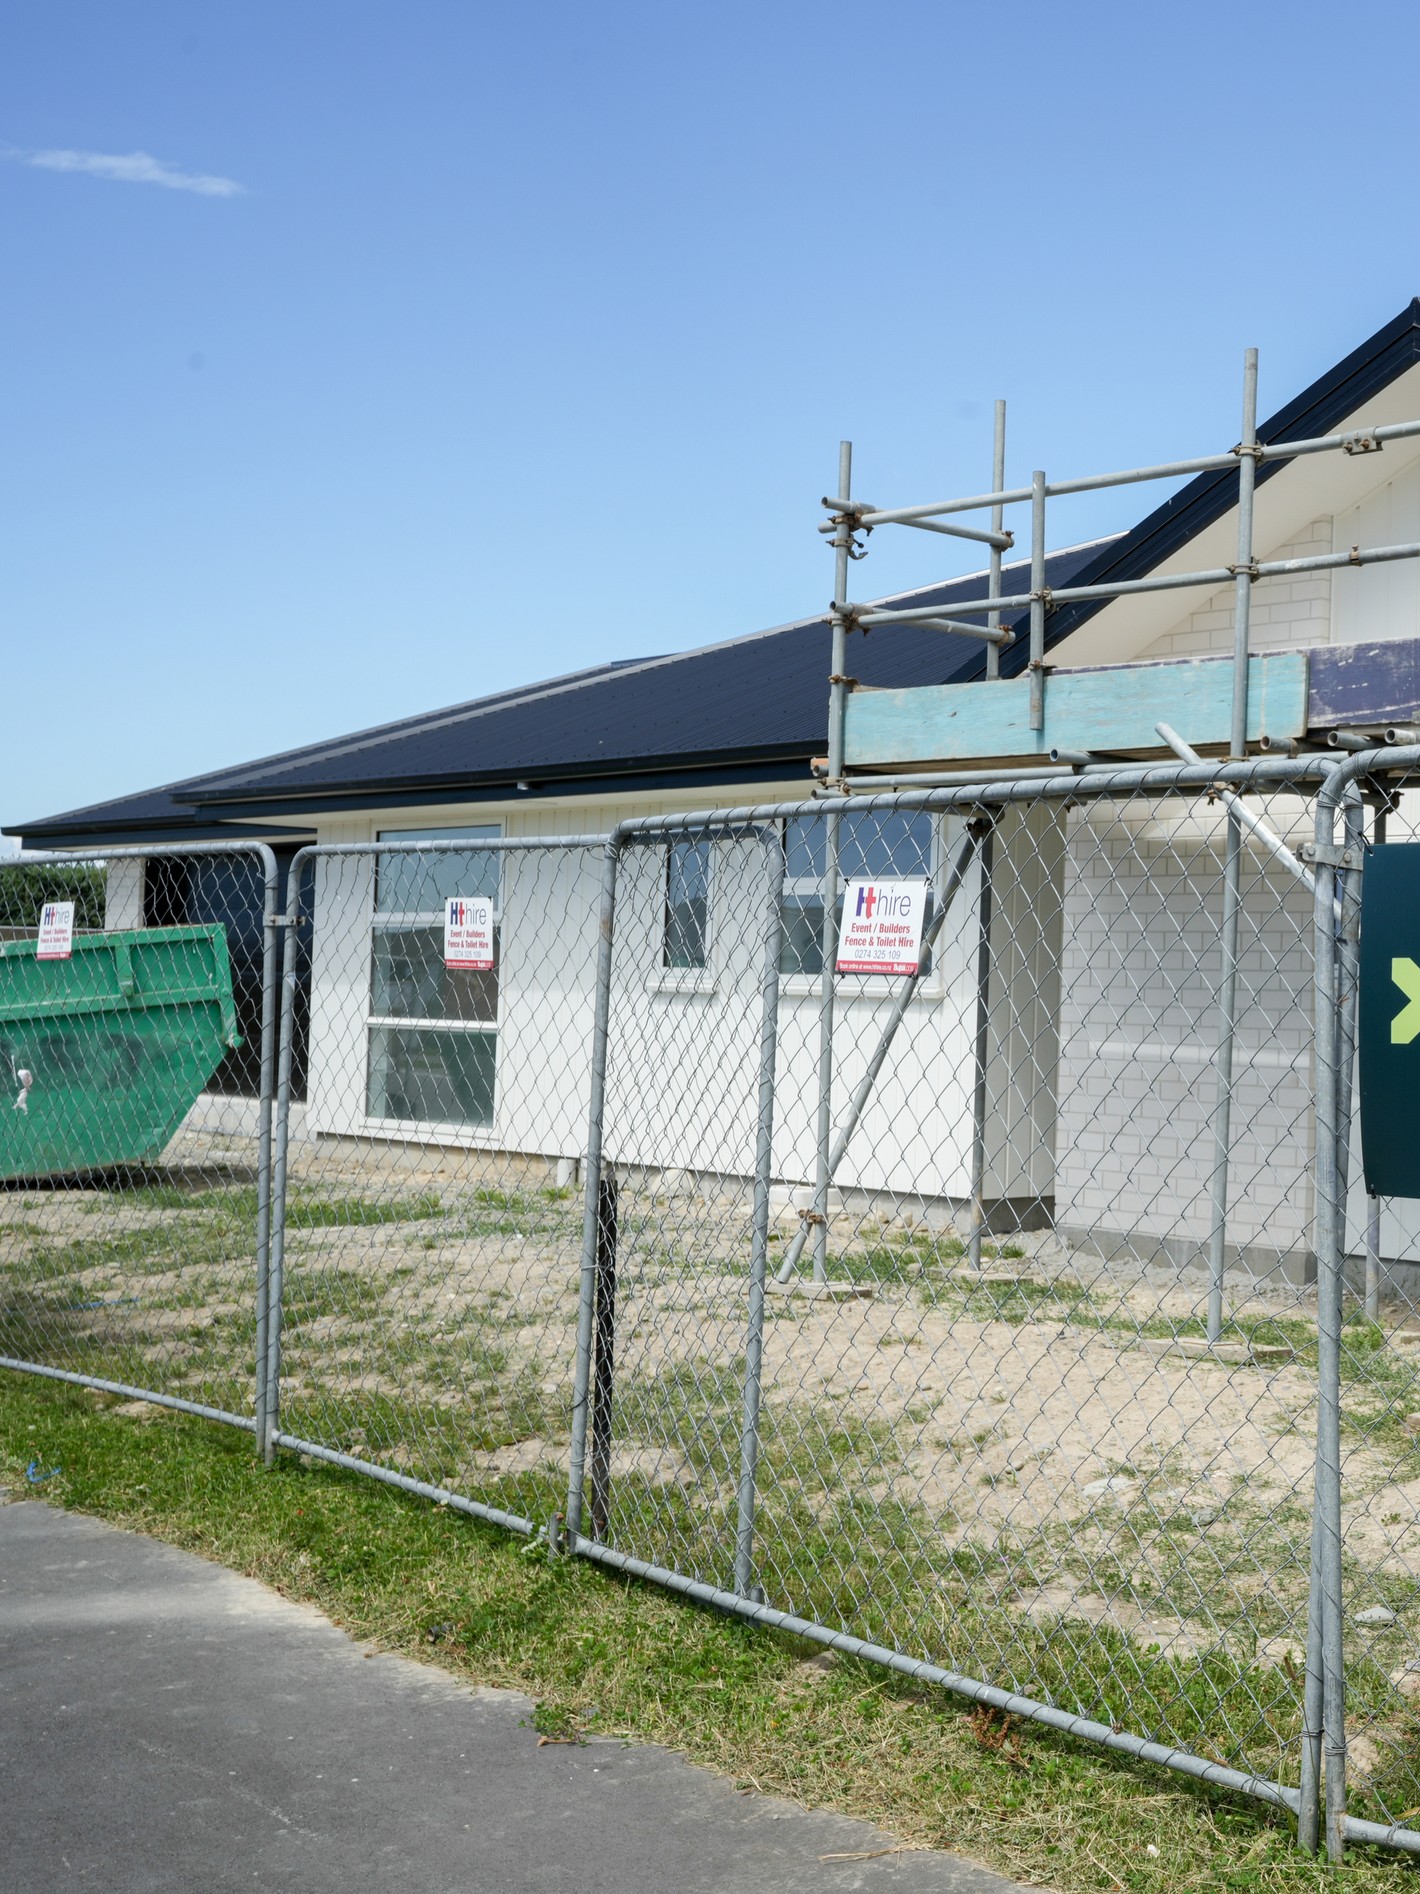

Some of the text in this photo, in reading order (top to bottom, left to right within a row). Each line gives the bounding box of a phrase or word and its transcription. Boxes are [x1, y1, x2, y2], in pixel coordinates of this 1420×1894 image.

[851, 923, 872, 933] Event
[879, 923, 911, 934] Builders
[450, 930, 463, 938] Event
[466, 930, 486, 939] Builders
[447, 940, 460, 948] Fence
[465, 941, 478, 949] Toilet
[478, 941, 489, 949] Hire
[844, 936, 914, 948] Fence & Toilet Hire
[854, 949, 901, 960] 0274 325 109
